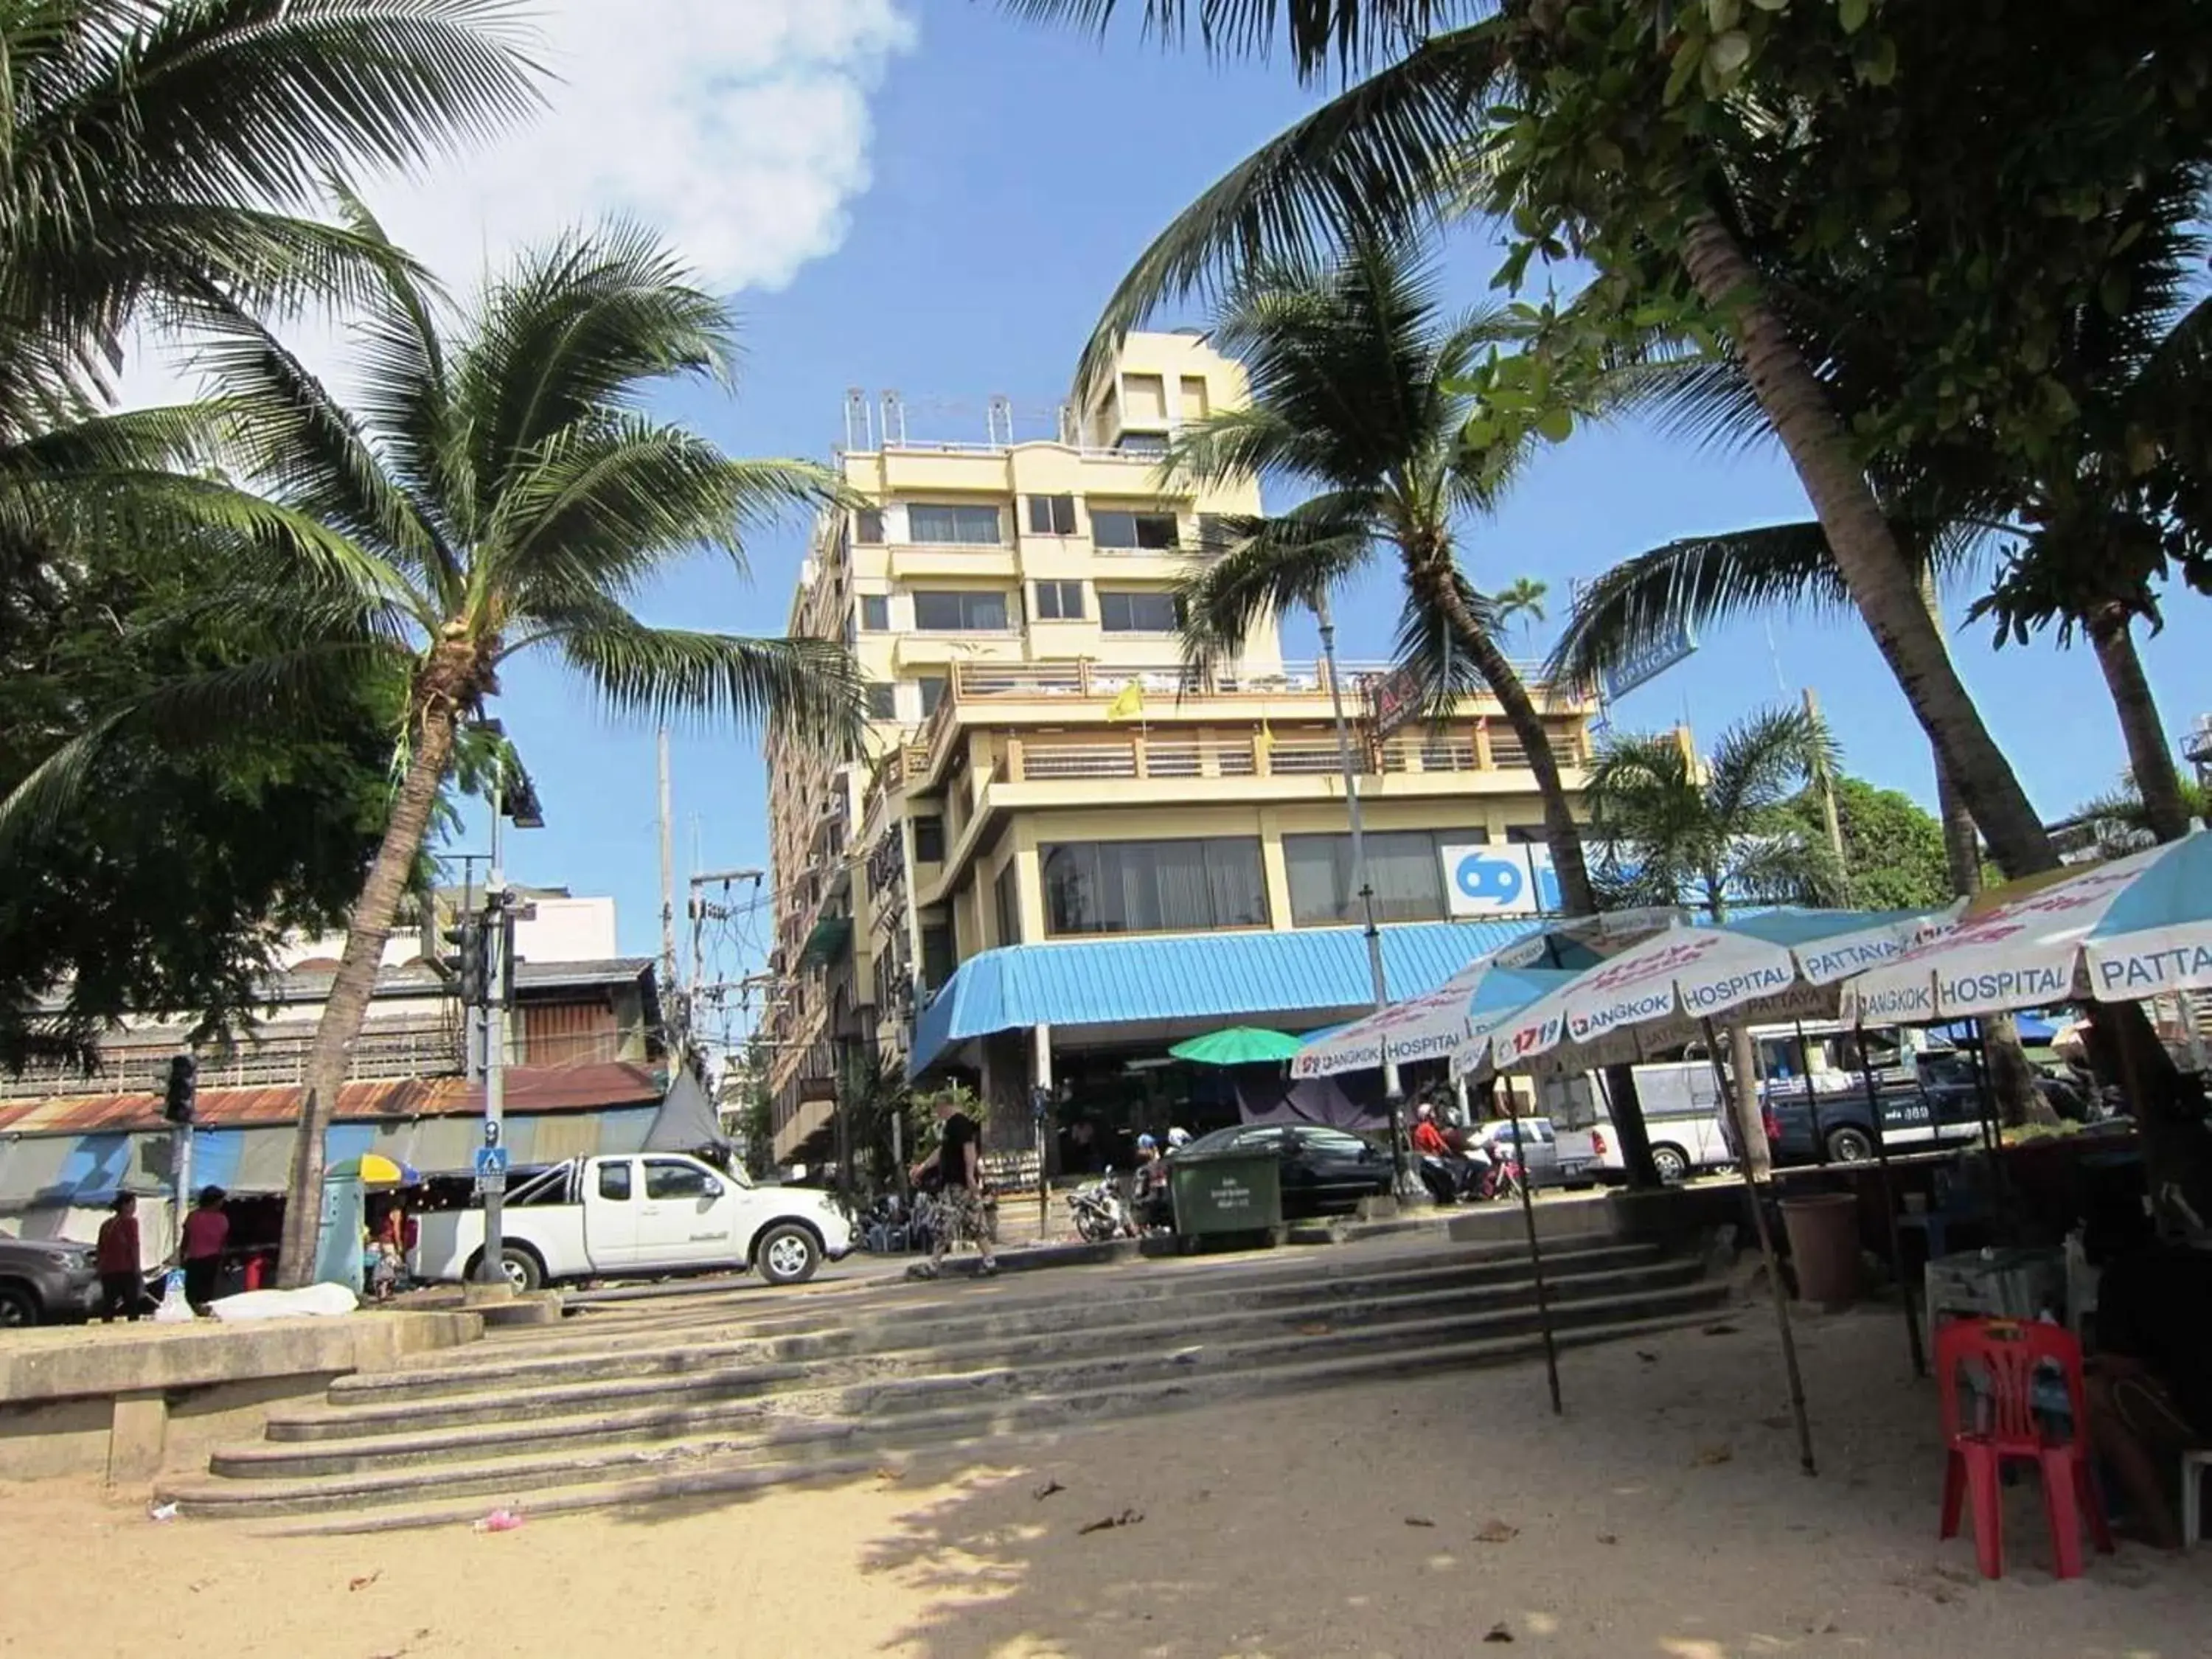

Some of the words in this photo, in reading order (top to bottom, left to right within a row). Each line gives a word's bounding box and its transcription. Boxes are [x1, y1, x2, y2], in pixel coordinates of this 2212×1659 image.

[1806, 941, 1899, 979] PATTAYA
[2101, 945, 2212, 990] PATTA
[1682, 965, 1791, 1010] HOSPITAL
[1939, 967, 2065, 1006] HOSPITAL
